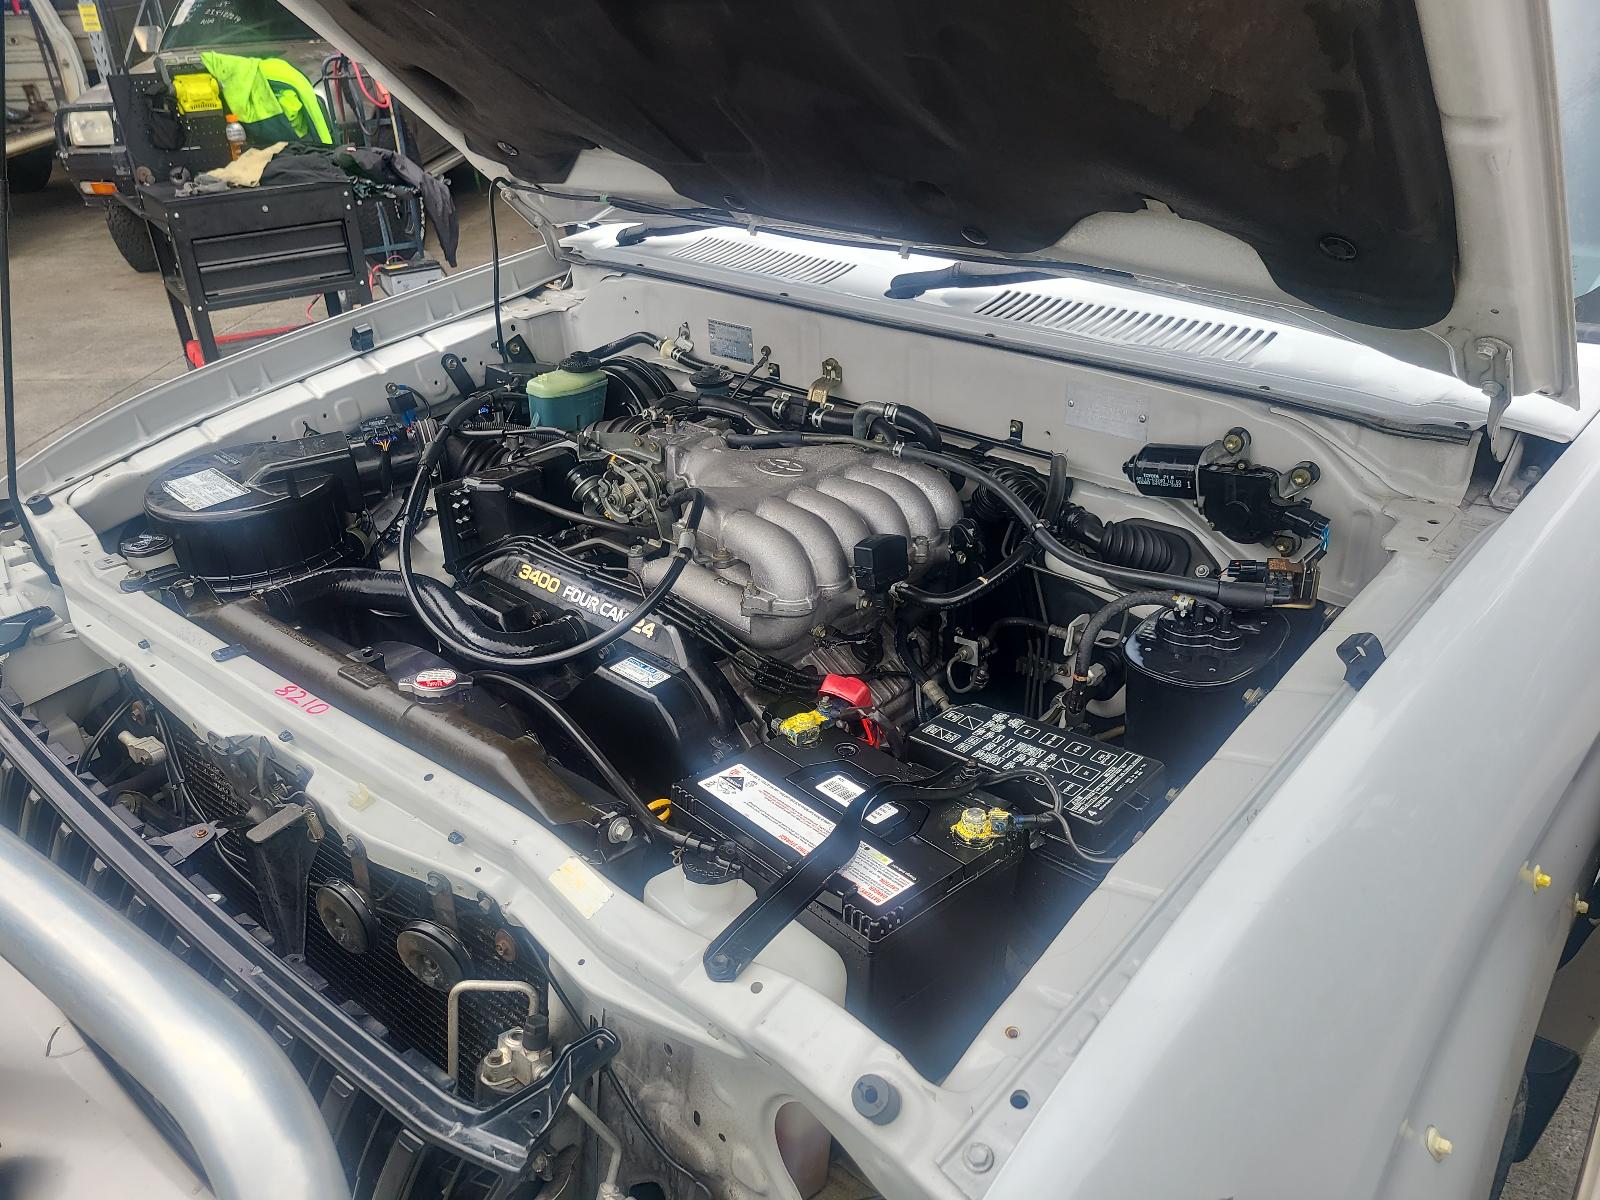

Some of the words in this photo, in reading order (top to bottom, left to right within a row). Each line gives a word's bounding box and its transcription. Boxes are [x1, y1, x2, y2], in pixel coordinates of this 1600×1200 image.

[518, 564, 561, 593] 3400
[562, 585, 600, 612] FOUR
[630, 618, 656, 639] 24
[274, 684, 331, 715] 8210
